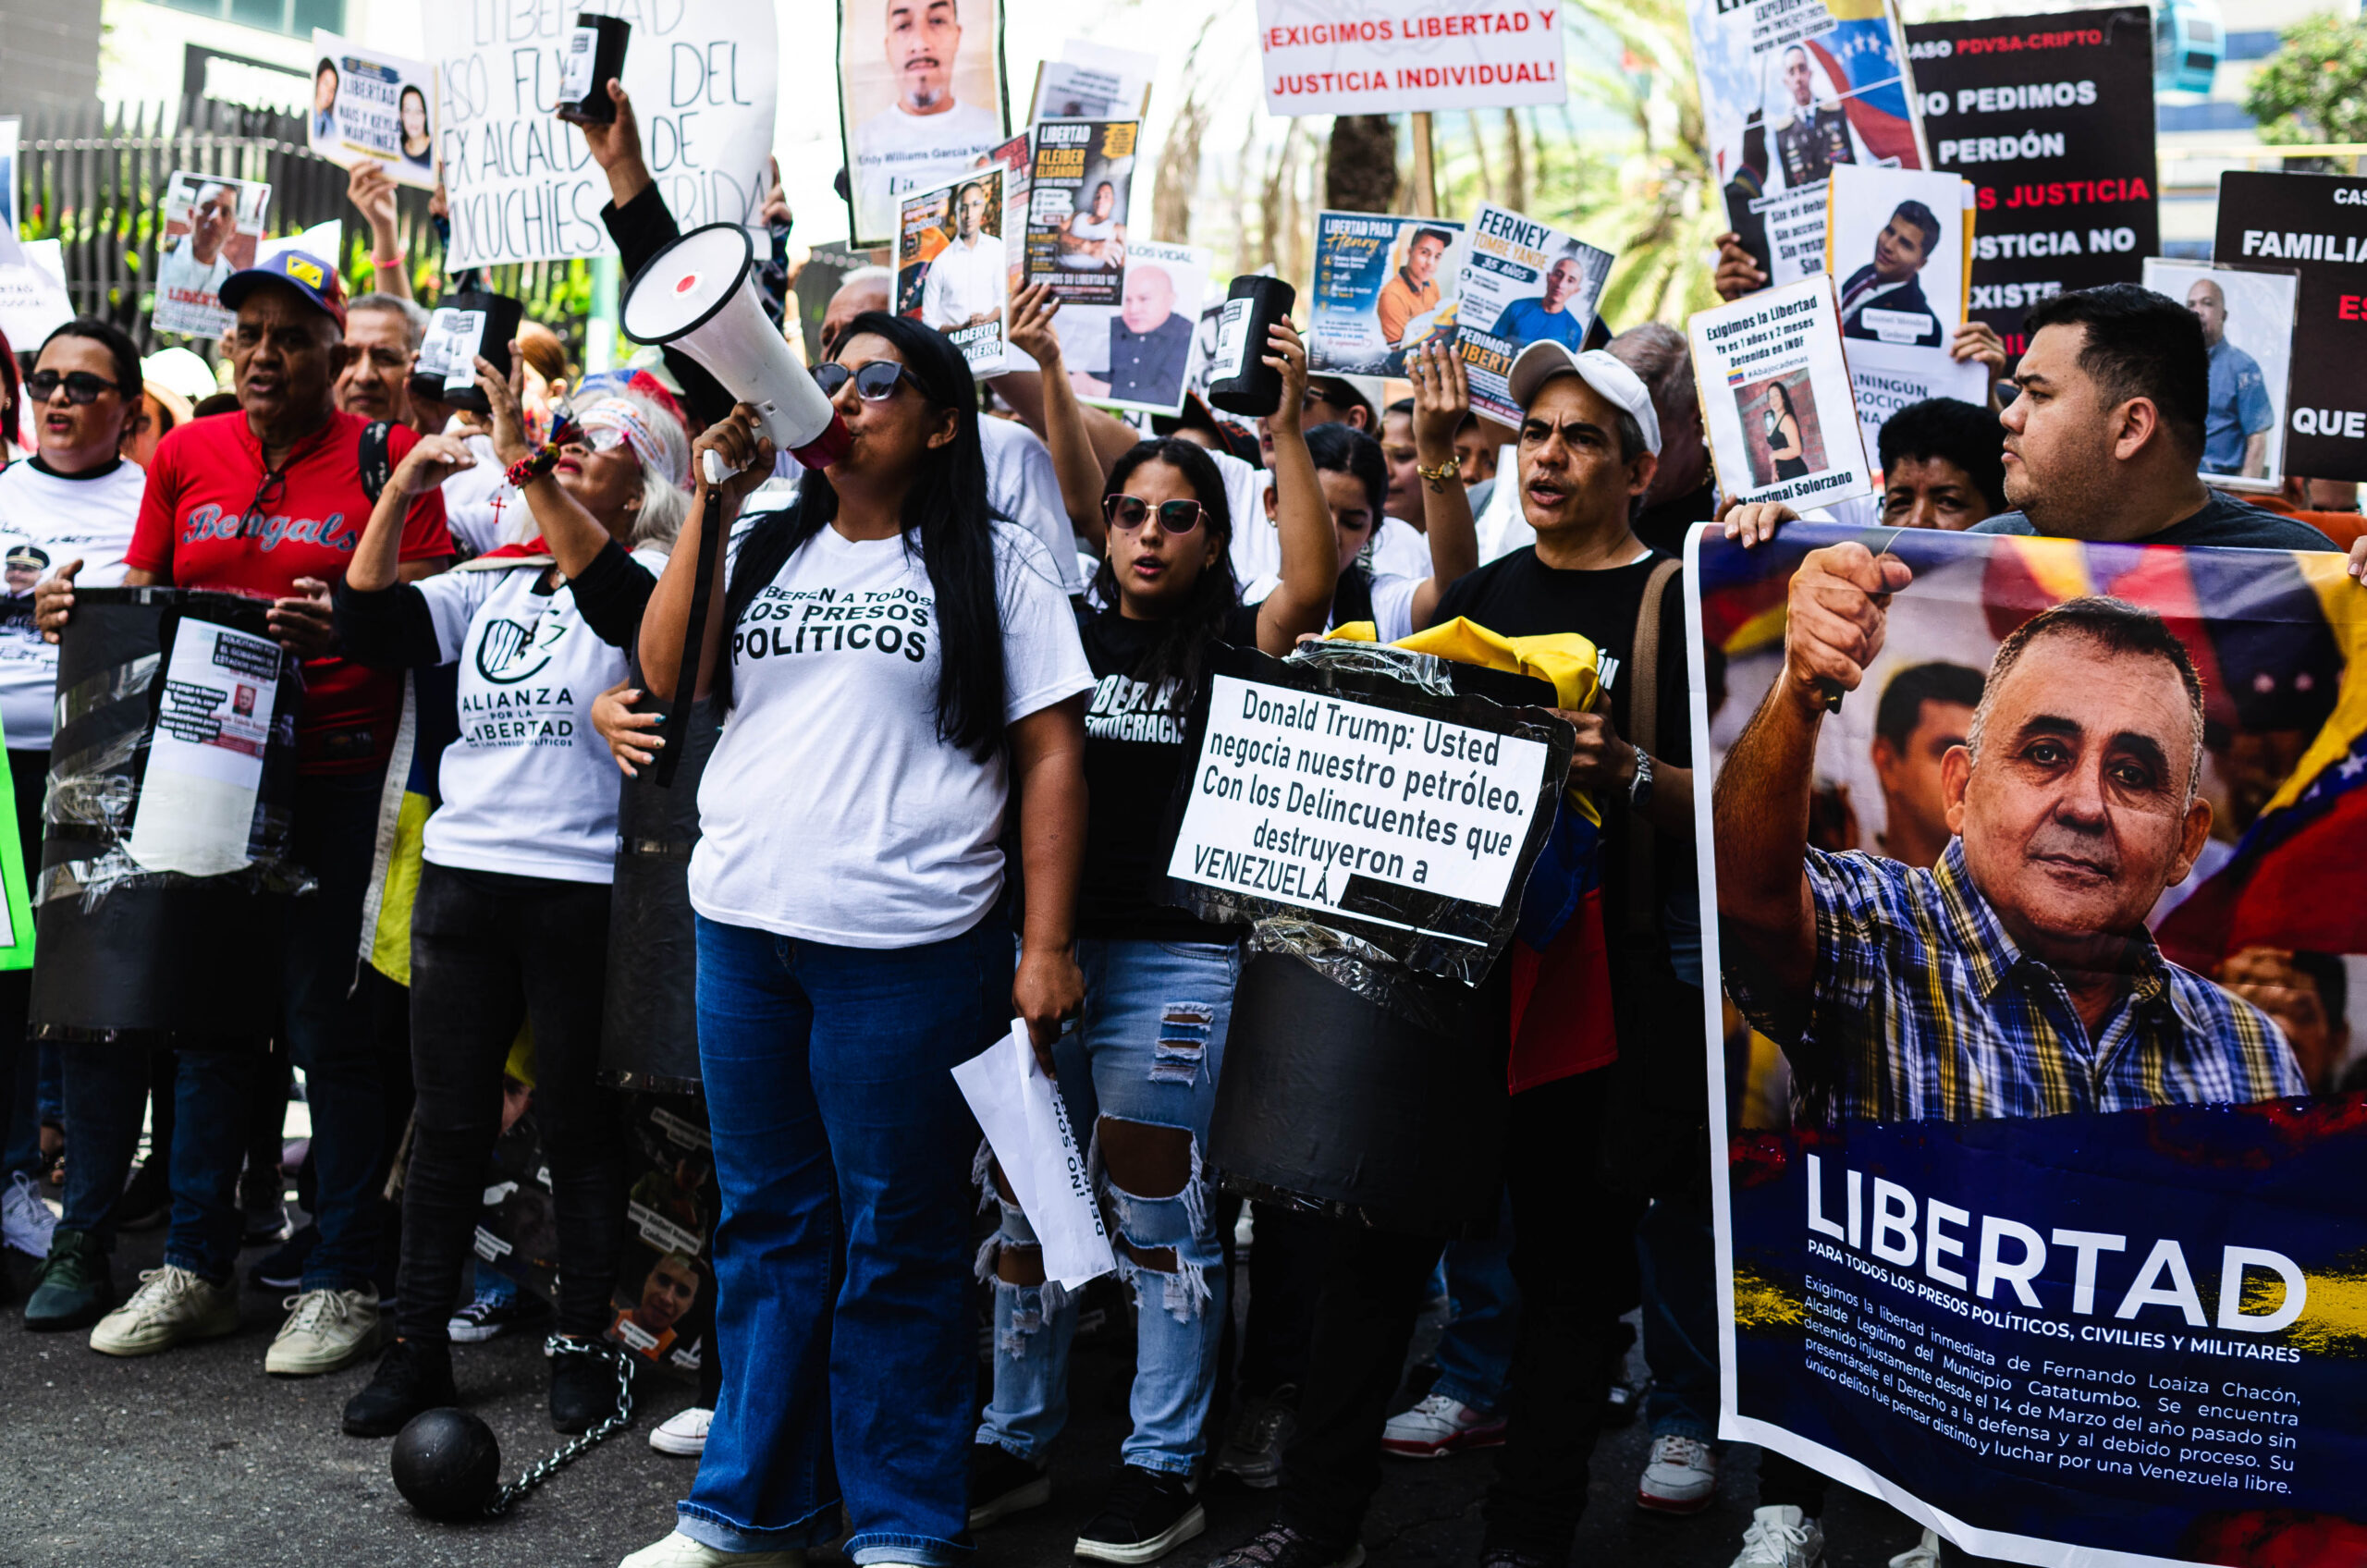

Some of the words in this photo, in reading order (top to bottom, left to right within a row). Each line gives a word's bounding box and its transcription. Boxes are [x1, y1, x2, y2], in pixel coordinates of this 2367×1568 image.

[1263, 21, 1393, 54] ¡EXIGIMOS
[1403, 12, 1530, 40] LIBERTAD
[1539, 10, 1555, 31] Y
[1908, 40, 1953, 59] ASO
[1956, 29, 2103, 55] PDVSA-CRIPTO
[513, 48, 570, 115] FU
[670, 41, 753, 108] DEL
[1273, 70, 1389, 95] JUSTICIA
[1396, 61, 1556, 90] INDIVIDUAL!
[1956, 80, 2097, 114] PEDIMOS
[483, 119, 592, 181] ALCALD
[652, 111, 700, 173] DE
[1039, 125, 1091, 143] LIBERTAD
[1939, 129, 2066, 165] PERDÓN
[657, 170, 773, 230] RIDA
[1977, 187, 1998, 211] S
[2006, 178, 2151, 207] JUSTICIA
[1325, 219, 1368, 236] LIBERTAD
[1369, 221, 1393, 239] PARA
[1325, 229, 1380, 255] Henry
[1473, 231, 1512, 258] TOMBE
[1479, 209, 1551, 251] FERNEY
[2089, 227, 2136, 253] NO
[1127, 245, 1155, 259] LOS
[1482, 258, 1500, 271] 35
[1500, 263, 1529, 281] AÑOS
[168, 286, 225, 310] LIBERT
[1707, 316, 1755, 340] Exigimos
[1757, 312, 1768, 325] la
[1770, 295, 1818, 321] Libertad
[963, 340, 1001, 361] OLERO
[1457, 326, 1513, 357] PEDIMOS
[1716, 345, 1726, 356] Ya
[1729, 342, 1738, 351] es
[1741, 338, 1745, 348] 1
[1747, 333, 1767, 346] años
[1769, 330, 1774, 340] y
[1775, 326, 1781, 337] 2
[1784, 318, 1814, 334] meses
[1730, 349, 1770, 367] Detenida
[1772, 345, 1783, 354] en
[1784, 336, 1804, 350] INOF
[1455, 337, 1515, 374] LIBERT
[1748, 356, 1809, 377] #Abajocadenas
[2292, 408, 2366, 437] QUE
[1794, 472, 1853, 496] Solorzano
[183, 504, 358, 552] Bengals
[841, 593, 854, 604] A
[864, 587, 932, 606] TODOS
[737, 603, 792, 628] LOS
[801, 604, 929, 628] PRESOS
[732, 620, 926, 667] POLÍTICOS
[462, 688, 573, 714] ALIANZA
[490, 711, 513, 721] POR
[518, 710, 533, 718] LA
[465, 720, 573, 742] LIBERTAD
[1242, 688, 1319, 731] Donald
[1326, 703, 1415, 755] Trump:
[1422, 720, 1502, 766] Usted
[1209, 731, 1291, 768] negocia
[1296, 748, 1395, 789] nuestro
[1403, 769, 1525, 816] petróleo.
[1203, 765, 1242, 801] Con
[1249, 774, 1280, 810] los
[1286, 781, 1457, 847] Delincuentes
[1466, 829, 1513, 861] que
[1253, 818, 1403, 879] destruyeron
[1413, 860, 1429, 884] a
[1052, 1101, 1072, 1149] SON
[1807, 1153, 2307, 1334] LIBERTAD
[1809, 1240, 1843, 1264] PARA
[1845, 1254, 1888, 1282] TODOS
[1891, 1272, 1915, 1294] LOS
[1918, 1283, 1968, 1317] PRESOS
[1972, 1310, 2075, 1341] POLÍTICOS,
[2080, 1326, 2165, 1349] CIVILIES
[2172, 1335, 2185, 1351] Y
[2190, 1337, 2300, 1364] MILITARES
[1805, 1275, 1858, 1307] Exigimos
[1864, 1298, 1873, 1315] la
[1880, 1305, 1924, 1336] libertad
[1931, 1327, 1995, 1366] inmediata
[2007, 1355, 2030, 1372] de
[2043, 1360, 2136, 1386] Fernando
[2149, 1374, 2209, 1394] Loaiza
[2222, 1382, 2300, 1406] Chacón,
[1804, 1296, 1848, 1323] Alcalde
[1858, 1317, 1906, 1350] Legítimo
[1915, 1343, 1933, 1363] del
[1944, 1355, 2012, 1390] Municipio
[2028, 1381, 2140, 1409] Catatumbo.
[2157, 1397, 2181, 1414] Se
[2198, 1404, 2299, 1427] encuentra
[1804, 1317, 1857, 1348] detenido
[1858, 1337, 1932, 1384] injustamente
[1935, 1375, 1972, 1402] desde
[1975, 1394, 1988, 1409] el
[1993, 1396, 2012, 1413] 14
[2017, 1402, 2042, 1418] de
[2048, 1406, 2106, 1427] Marzo
[2113, 1415, 2142, 1432] del
[2149, 1420, 2185, 1437] año
[2191, 1427, 2263, 1445] pasado
[2268, 1433, 2296, 1450] sin
[1805, 1338, 1879, 1380] presentársele
[1883, 1373, 1894, 1388] el
[1897, 1378, 1946, 1413] Derecho
[1951, 1405, 1958, 1417] a
[1963, 1408, 1973, 1425] la
[1978, 1416, 2050, 1441] defensa
[2057, 1432, 2070, 1447] y
[2078, 1433, 2093, 1448] al
[2103, 1435, 2170, 1457] debido
[2179, 1448, 2261, 1468] proceso.
[2269, 1455, 2294, 1472] Su
[1805, 1355, 1836, 1380] único
[1838, 1372, 1870, 1396] delito
[1872, 1385, 1890, 1405] fue
[1892, 1397, 1932, 1429] pensar
[1932, 1417, 1977, 1449] distinto
[1979, 1441, 1991, 1456] y
[1994, 1440, 2054, 1464] luchar
[2059, 1453, 2091, 1469] por
[2096, 1460, 2132, 1476] una
[2139, 1462, 2238, 1488] Venezuela
[2244, 1474, 2292, 1495] libre.
